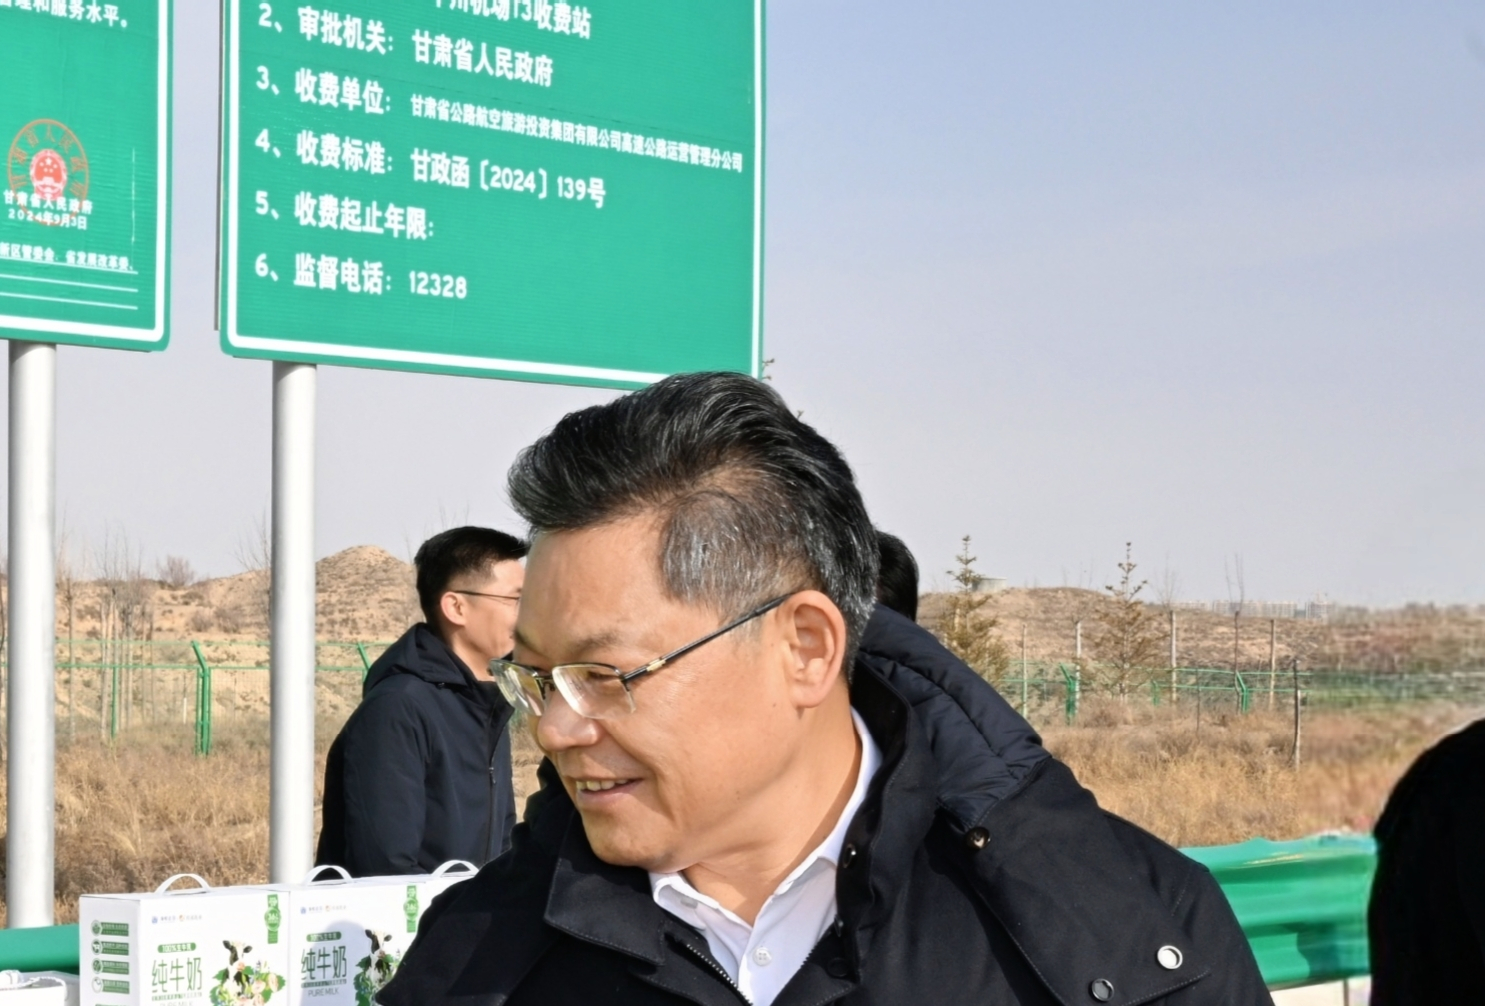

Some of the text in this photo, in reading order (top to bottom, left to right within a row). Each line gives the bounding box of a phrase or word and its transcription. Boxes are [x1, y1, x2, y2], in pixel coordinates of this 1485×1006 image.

[3, 189, 93, 215] 甘肃省人民政府
[255, 190, 435, 241] 5、收费起止年限：
[8, 208, 88, 230] 2024年9月3日
[152, 957, 202, 993] 纯牛奶
[301, 946, 347, 980] 纯牛奶
[307, 987, 340, 997] PURE MILK
